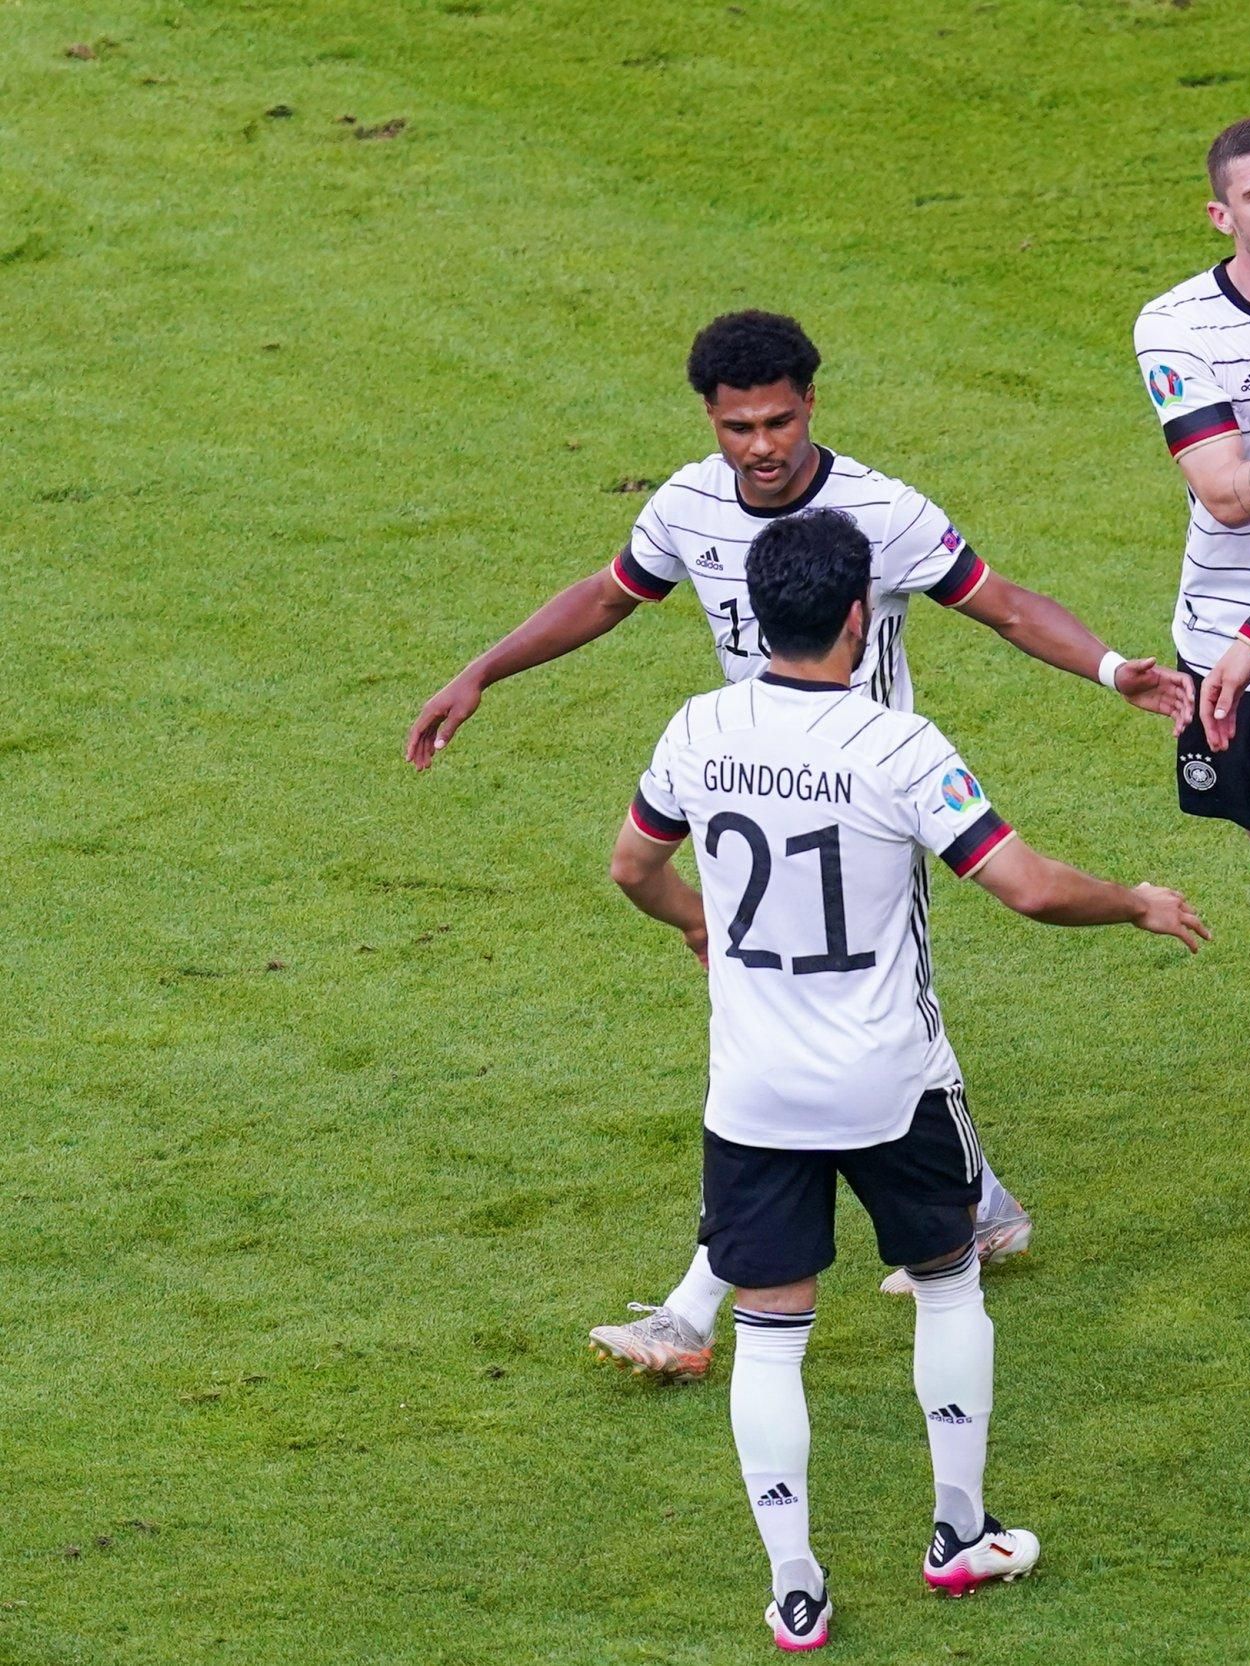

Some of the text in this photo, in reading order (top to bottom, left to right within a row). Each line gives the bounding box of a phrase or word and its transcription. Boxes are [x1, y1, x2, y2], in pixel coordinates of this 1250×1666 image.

[695, 558, 724, 571] adidas
[704, 755, 852, 804] GÜNDOĞAN
[705, 811, 877, 976] 21
[928, 1414, 973, 1425] adidas
[757, 1496, 799, 1507] adidas
